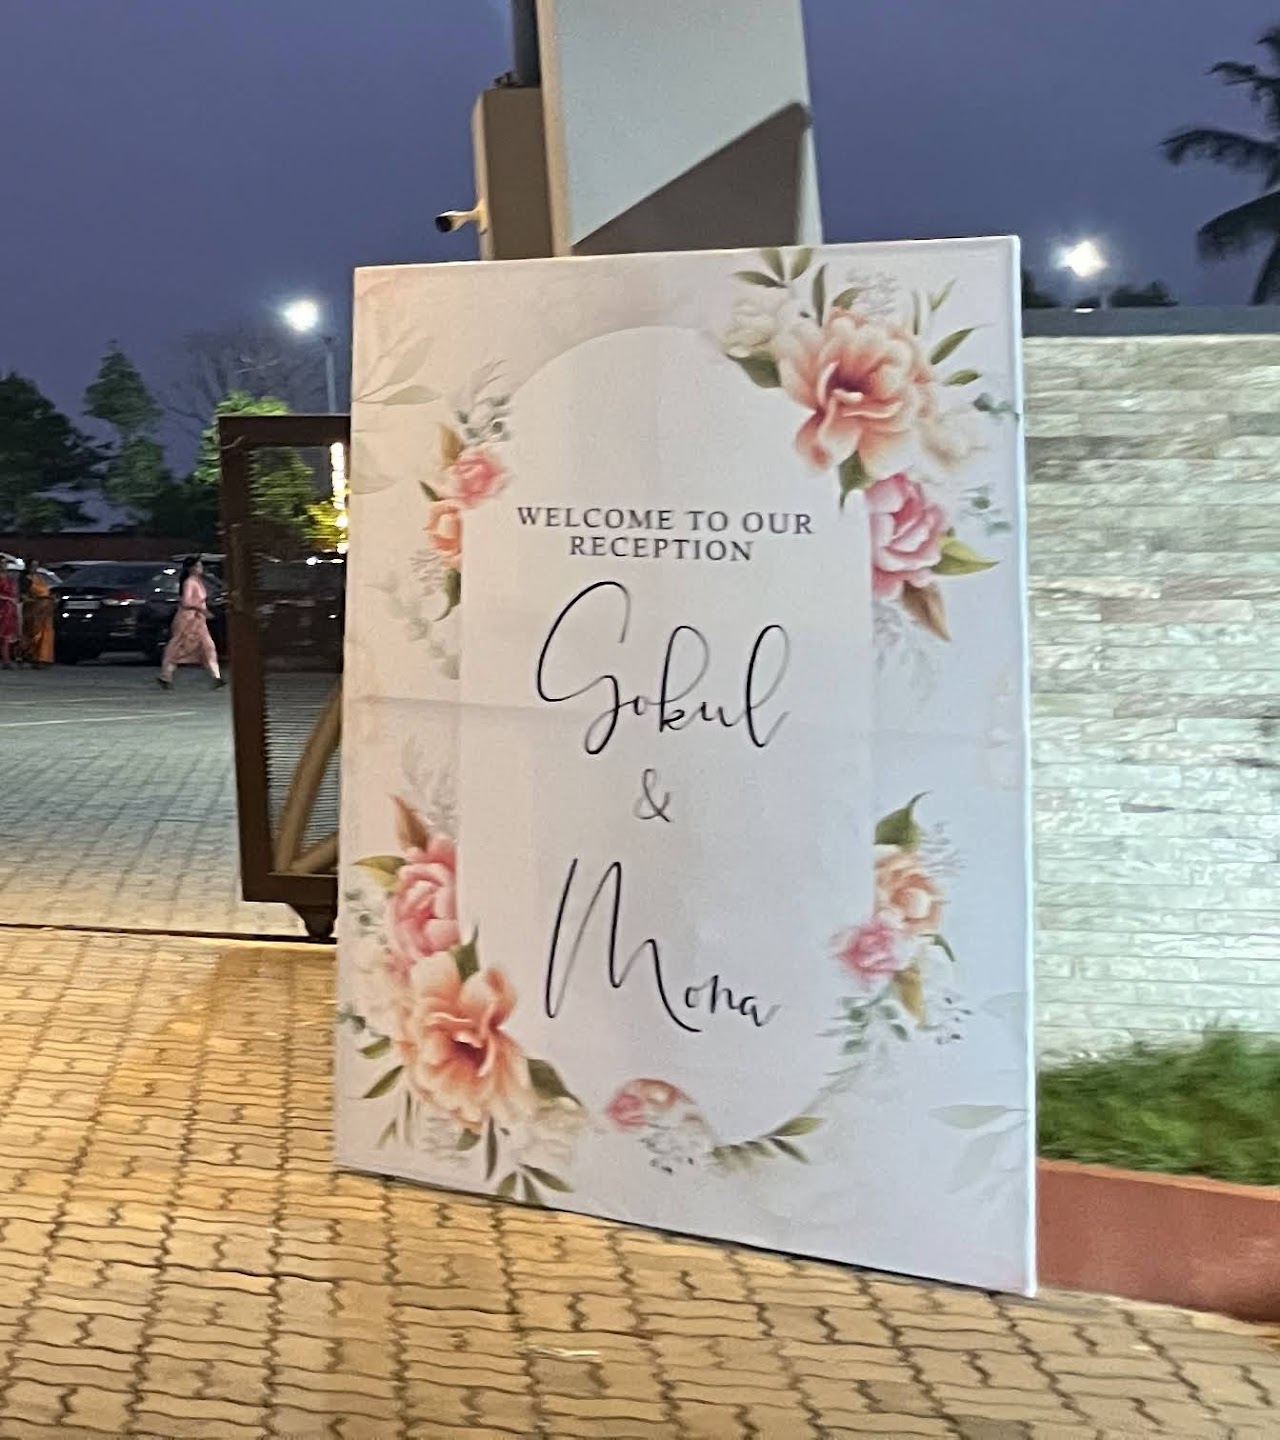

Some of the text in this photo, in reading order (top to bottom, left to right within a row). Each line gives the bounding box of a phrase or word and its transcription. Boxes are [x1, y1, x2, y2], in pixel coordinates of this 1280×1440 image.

[517, 507, 815, 535] WELCOME TO OUR
[569, 536, 755, 561] RECEPTION
[537, 580, 791, 755] Gokul
[633, 768, 673, 823] &
[545, 857, 782, 1033] Mona
